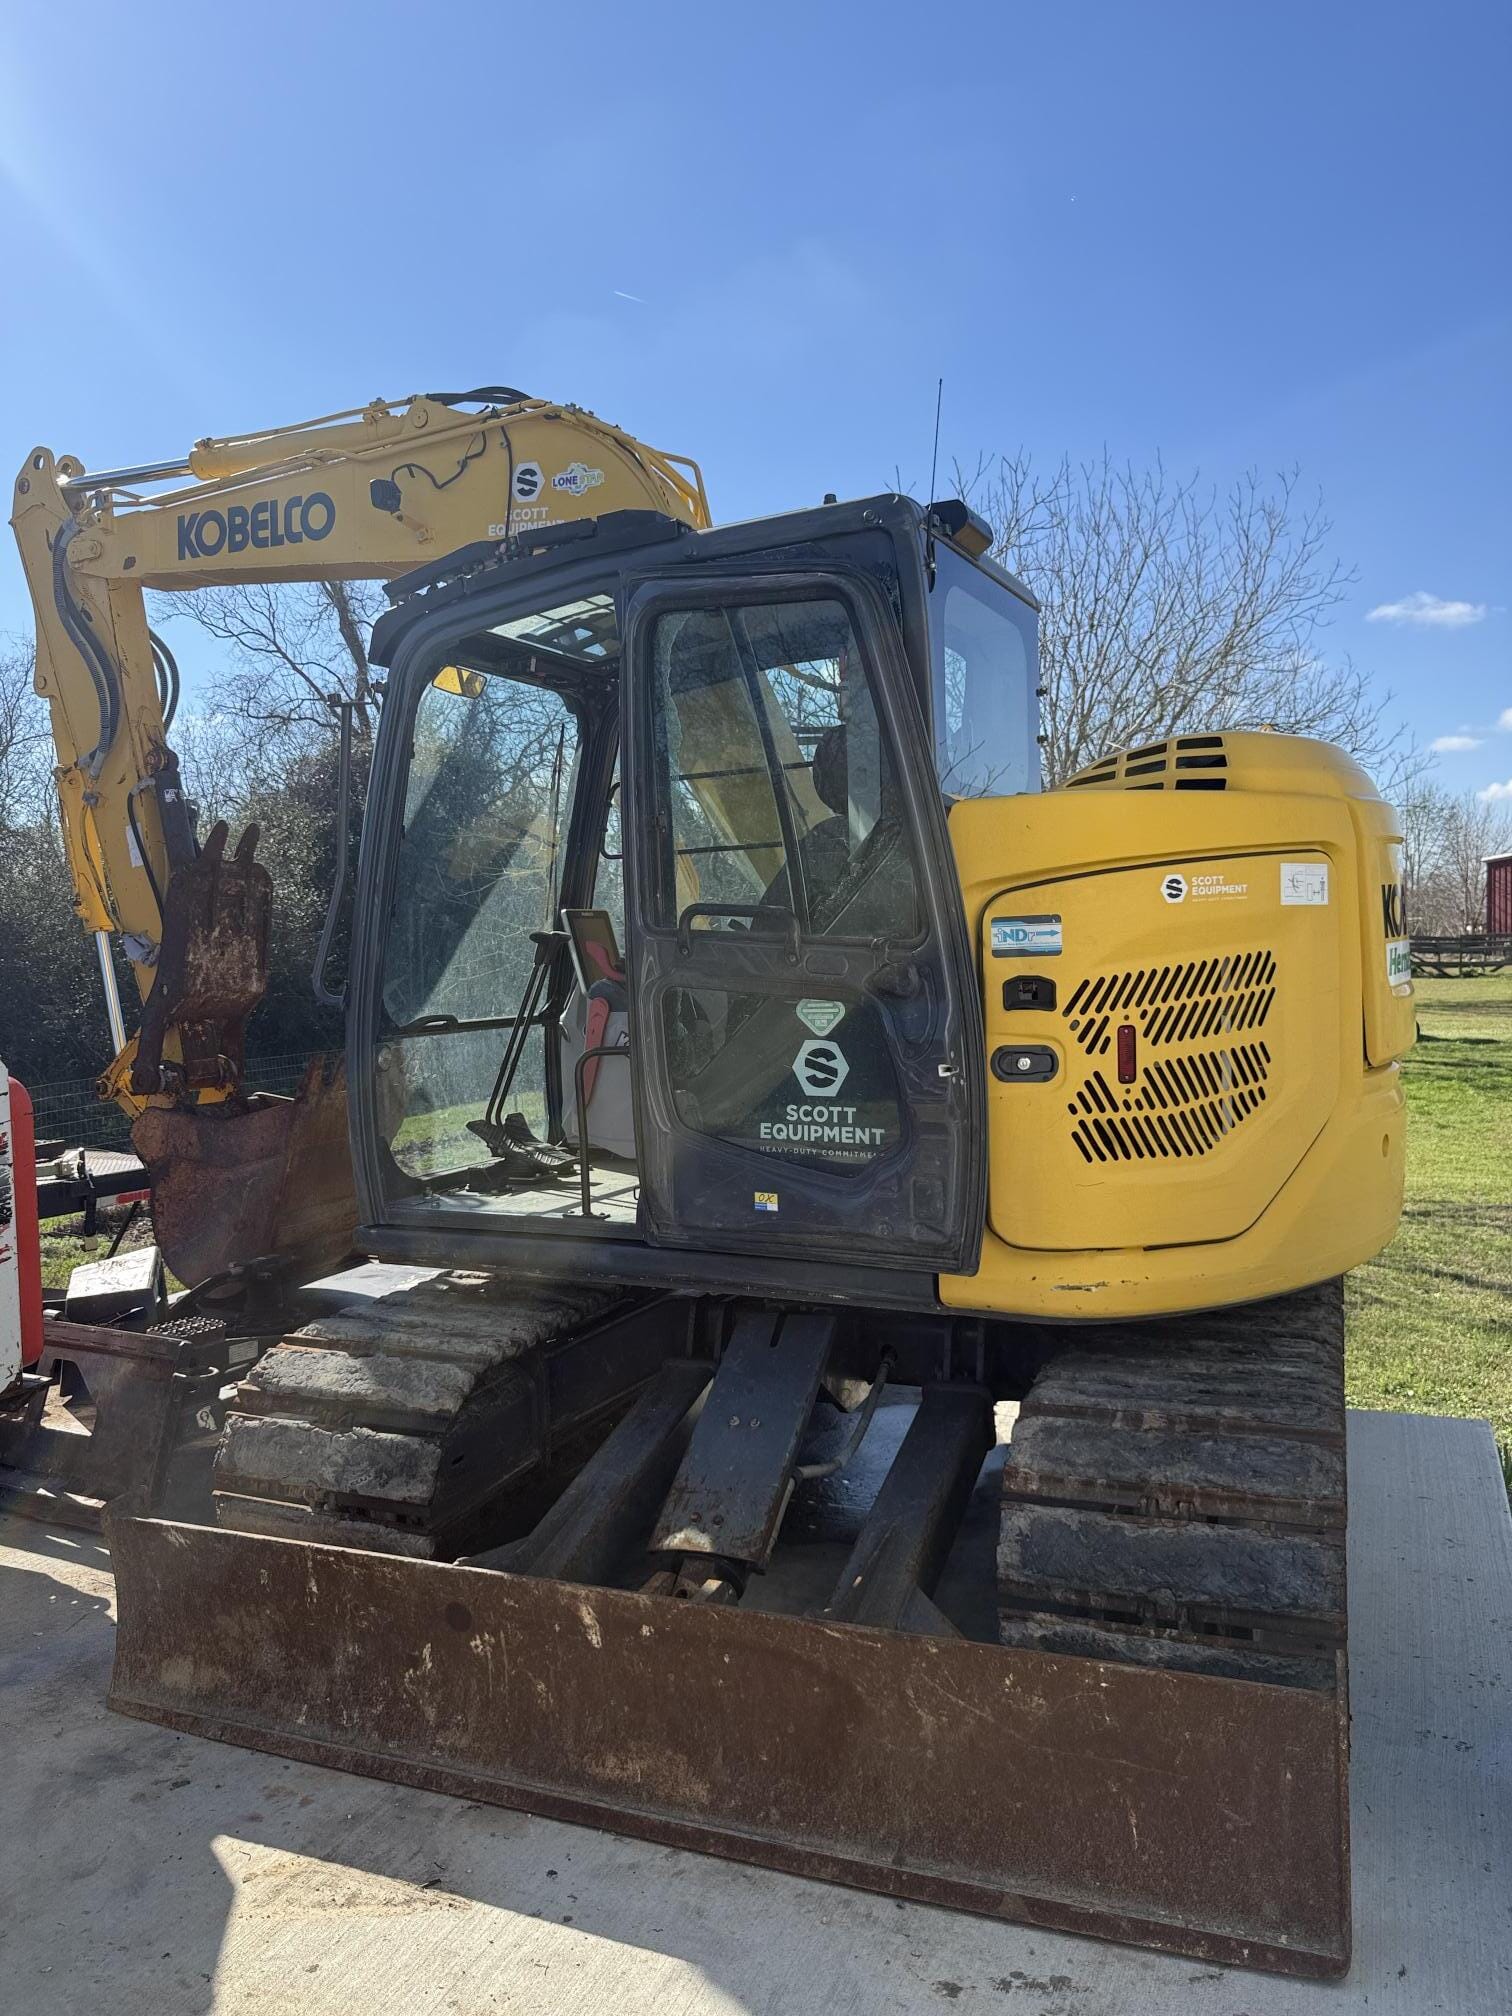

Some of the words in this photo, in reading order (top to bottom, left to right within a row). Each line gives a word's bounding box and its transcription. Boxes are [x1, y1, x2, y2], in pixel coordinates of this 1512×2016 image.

[552, 476, 578, 488] LONE
[177, 491, 336, 561] KOBELCO
[1191, 875, 1225, 886] SCOTT
[1191, 884, 1248, 896] EQUIPMENT
[785, 1105, 857, 1124] SCOTT
[759, 1122, 885, 1146] EQUIPMENT
[759, 1146, 817, 1156] HEAVY-DUTY
